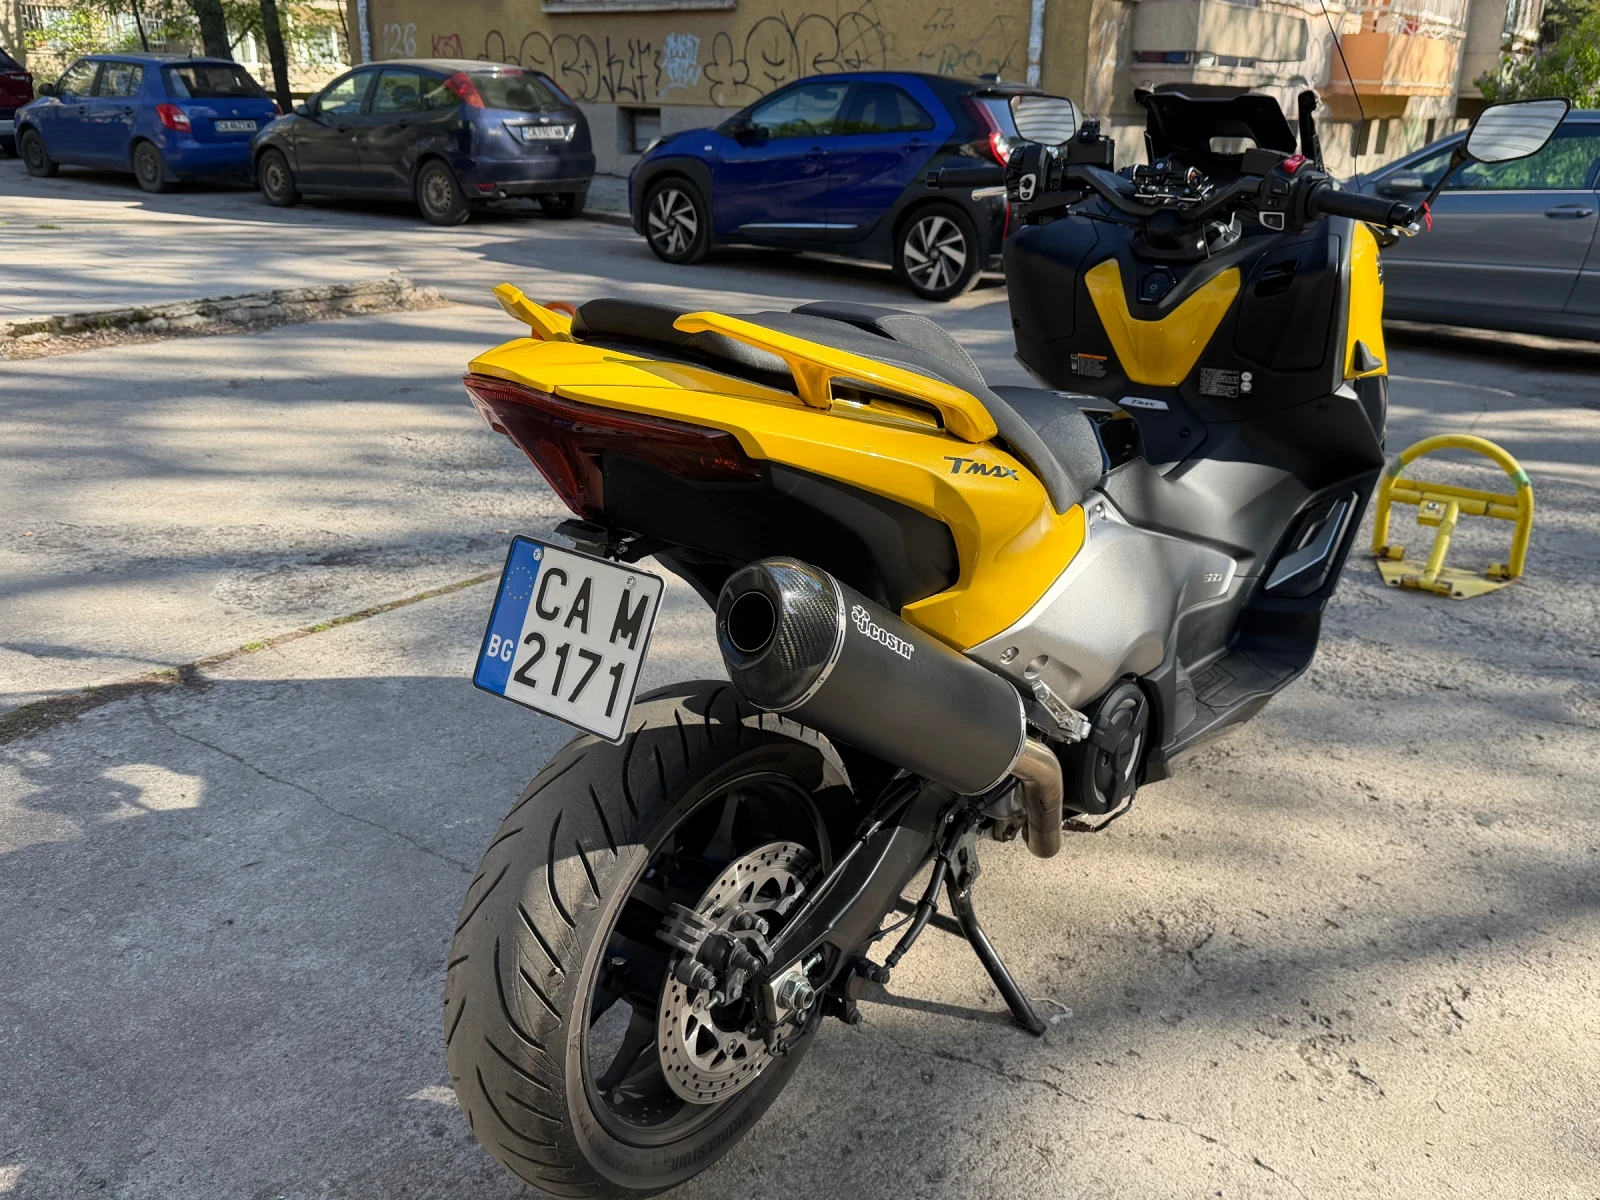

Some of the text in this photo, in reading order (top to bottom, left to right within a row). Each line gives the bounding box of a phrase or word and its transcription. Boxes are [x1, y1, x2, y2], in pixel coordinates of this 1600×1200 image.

[383, 22, 417, 57] 126
[944, 456, 1020, 481] TMAX
[535, 567, 650, 651] CA M
[486, 633, 514, 662] BG
[513, 632, 625, 718] 2171
